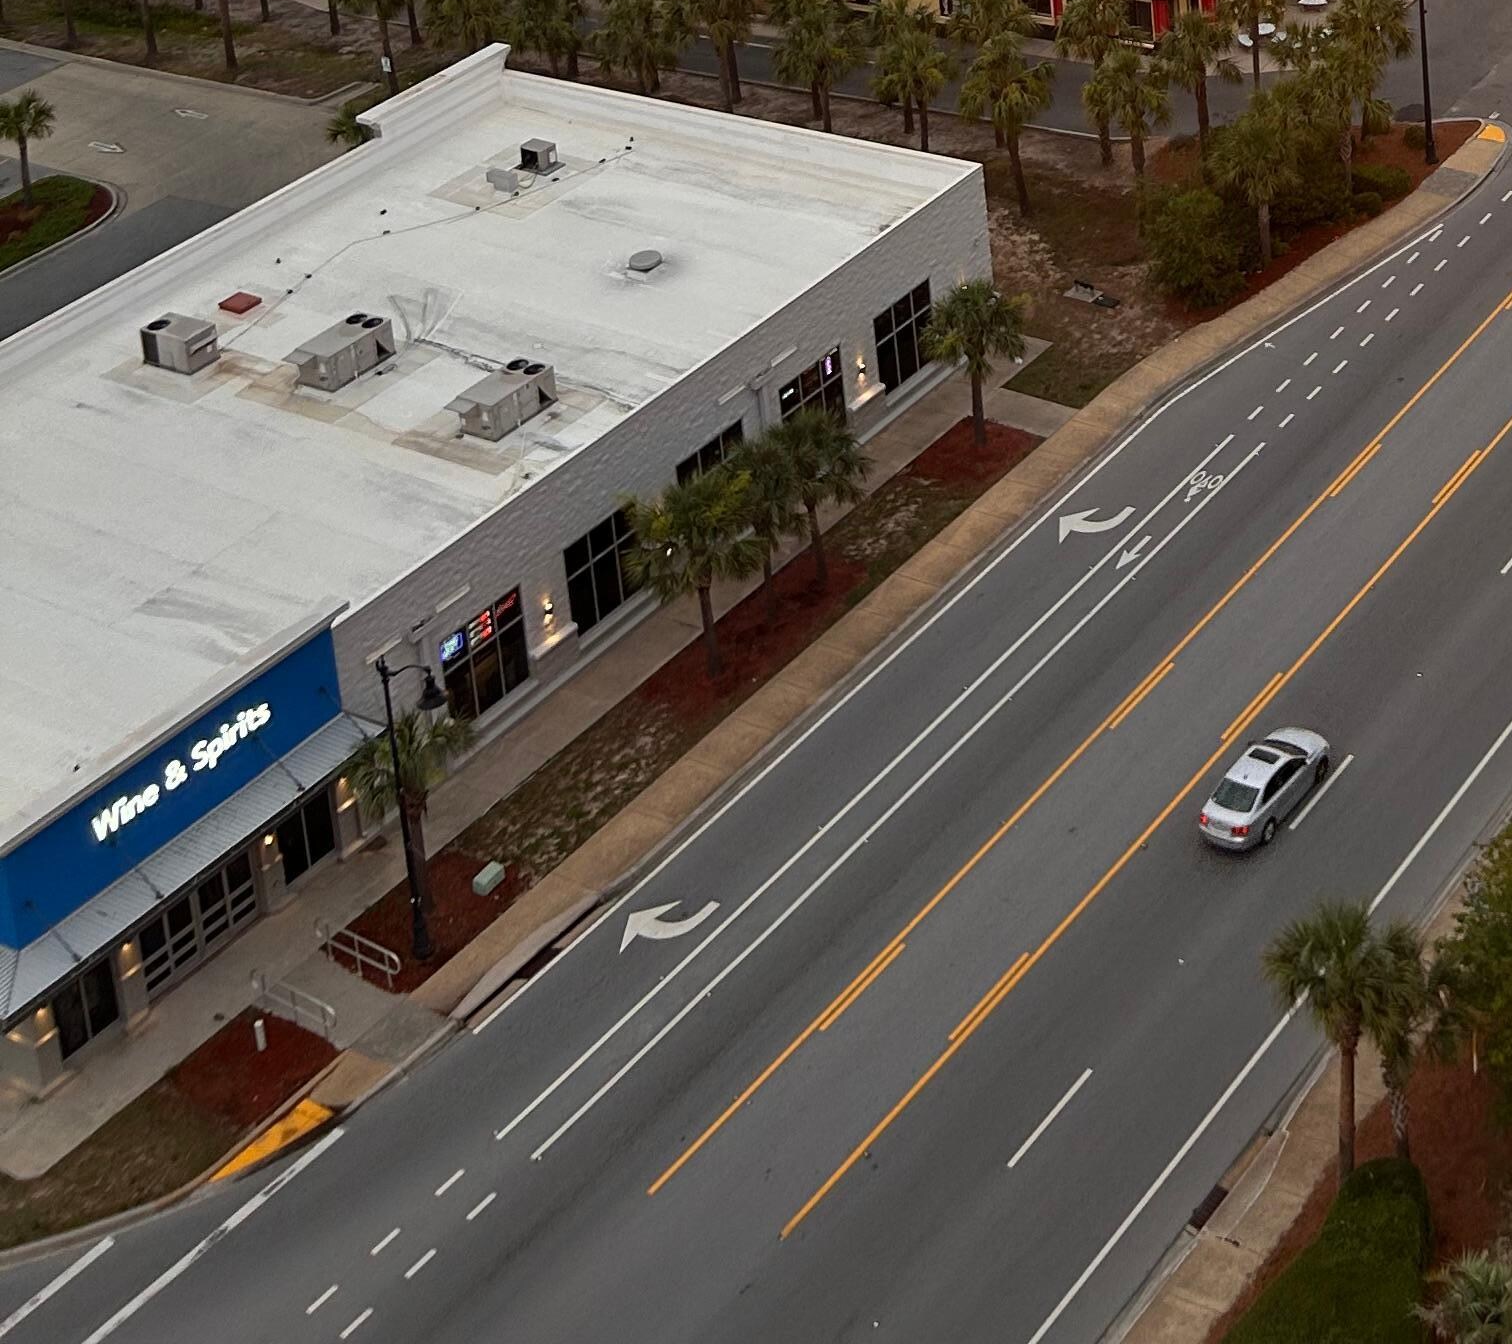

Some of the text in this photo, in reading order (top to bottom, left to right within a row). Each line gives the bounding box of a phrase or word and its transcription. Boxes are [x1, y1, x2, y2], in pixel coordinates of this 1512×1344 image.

[90, 701, 272, 842] Wine & Spirits
